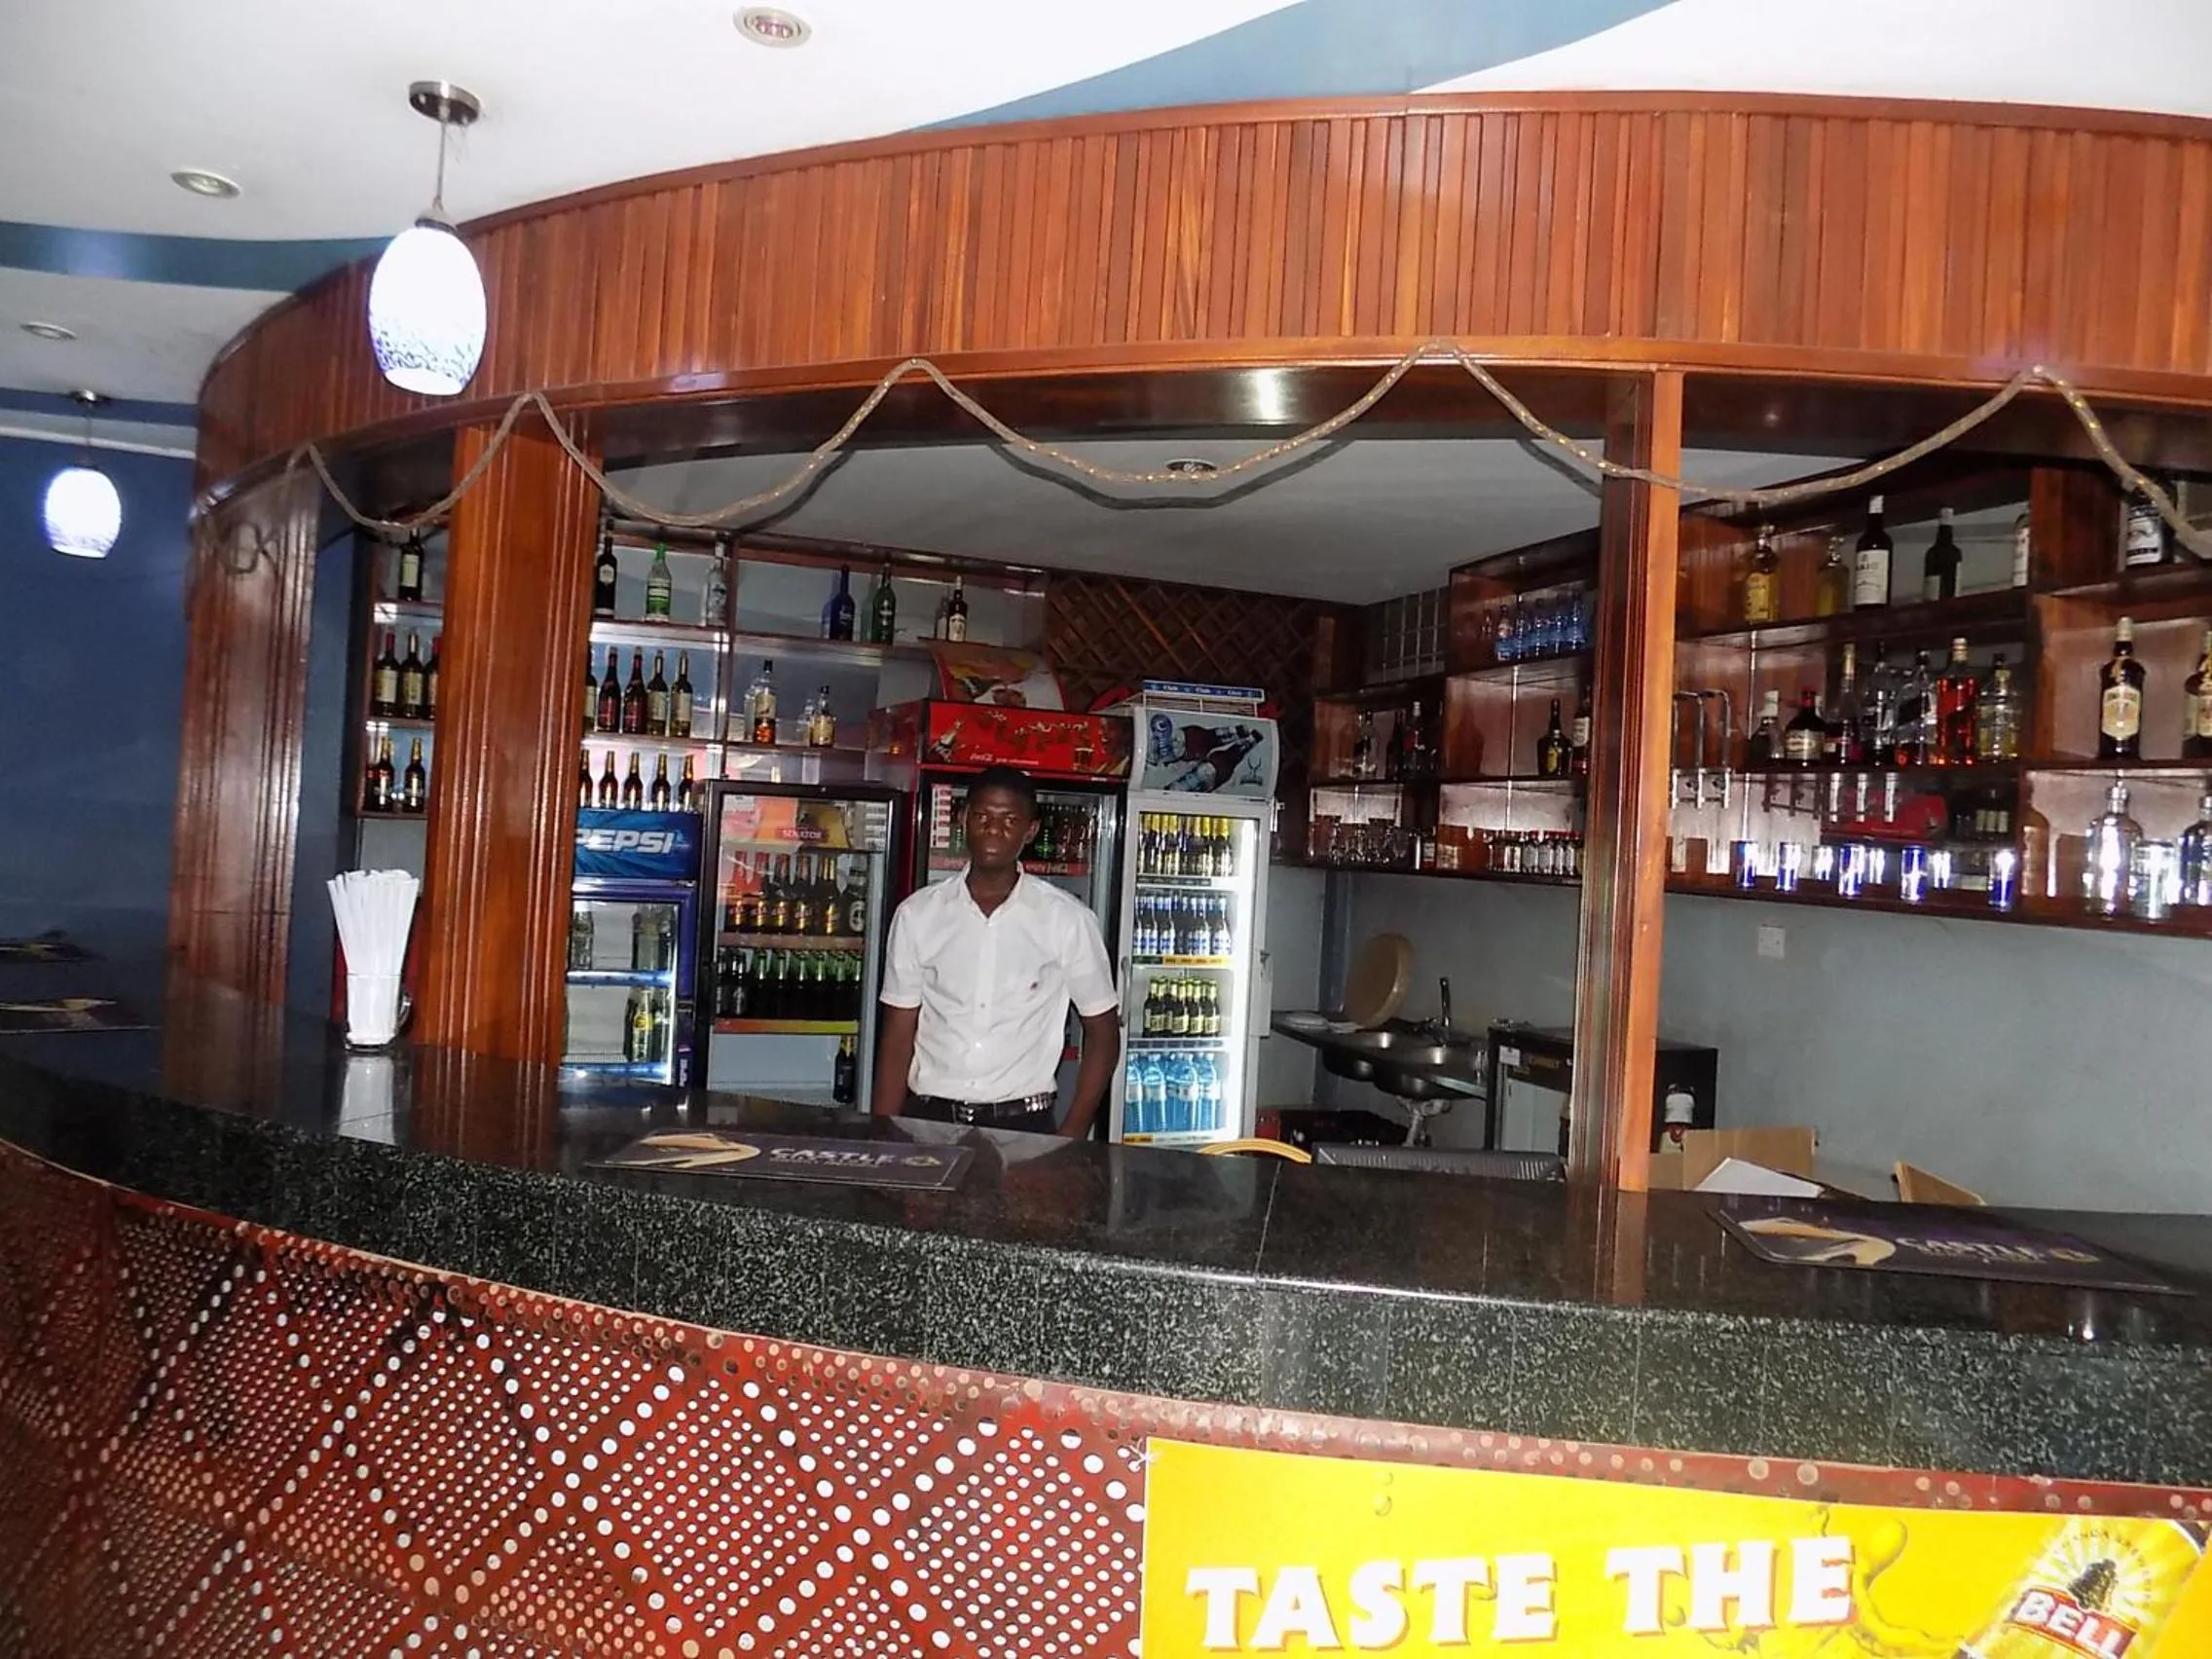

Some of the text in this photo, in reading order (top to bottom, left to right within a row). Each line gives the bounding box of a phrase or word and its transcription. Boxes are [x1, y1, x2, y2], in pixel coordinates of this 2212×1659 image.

[1185, 1535, 1858, 1652] TASTE THE
[2010, 1590, 2123, 1659] BELL
